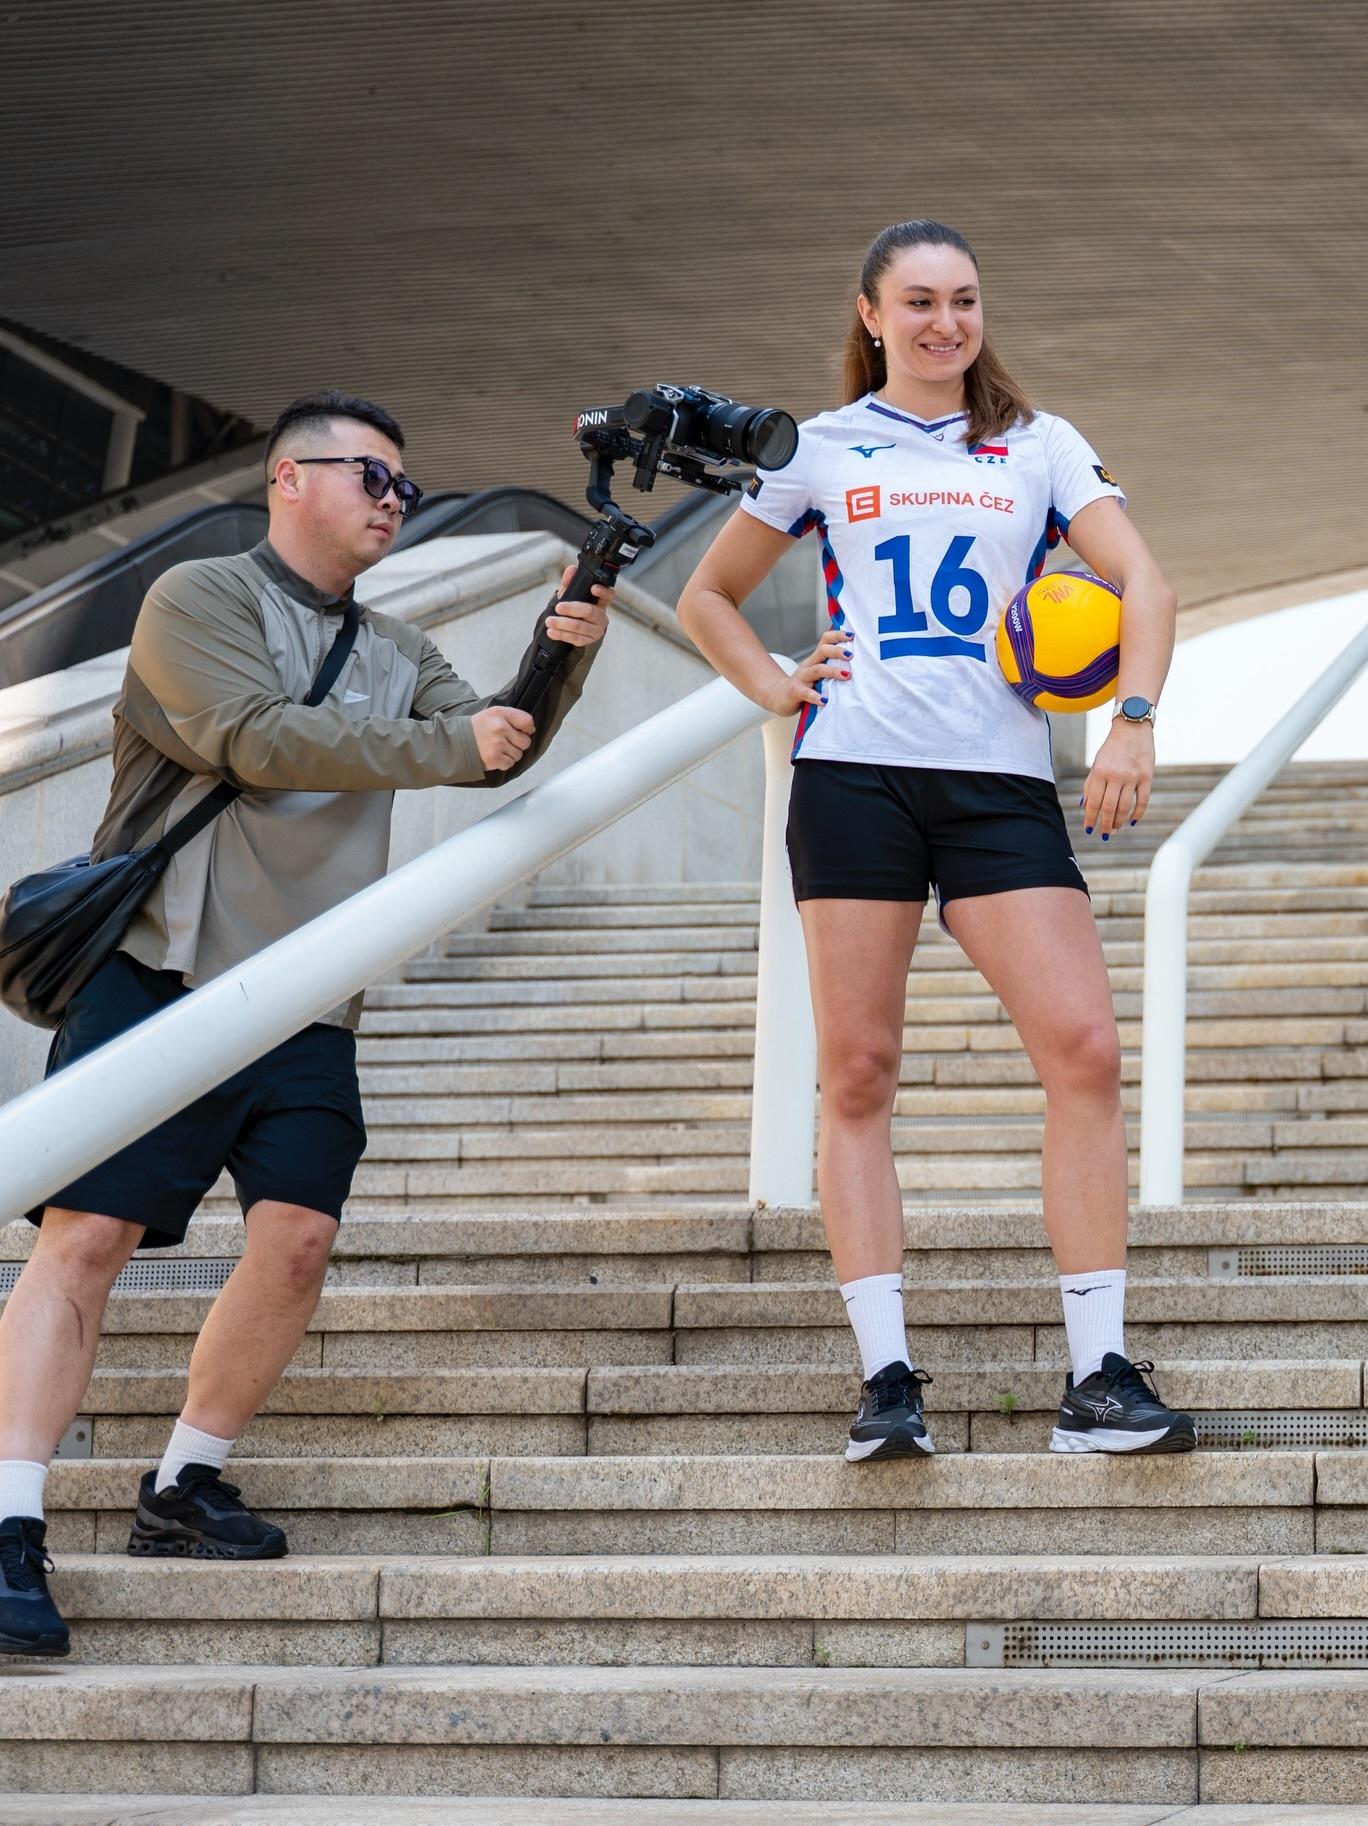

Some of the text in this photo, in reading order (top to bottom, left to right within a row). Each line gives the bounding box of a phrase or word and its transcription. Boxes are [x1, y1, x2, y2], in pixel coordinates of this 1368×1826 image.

[575, 410, 608, 431] ONIN
[974, 456, 1007, 464] CZE
[889, 492, 975, 506] SKUPINA
[979, 491, 1014, 514] ČEZ
[875, 535, 989, 636] 16
